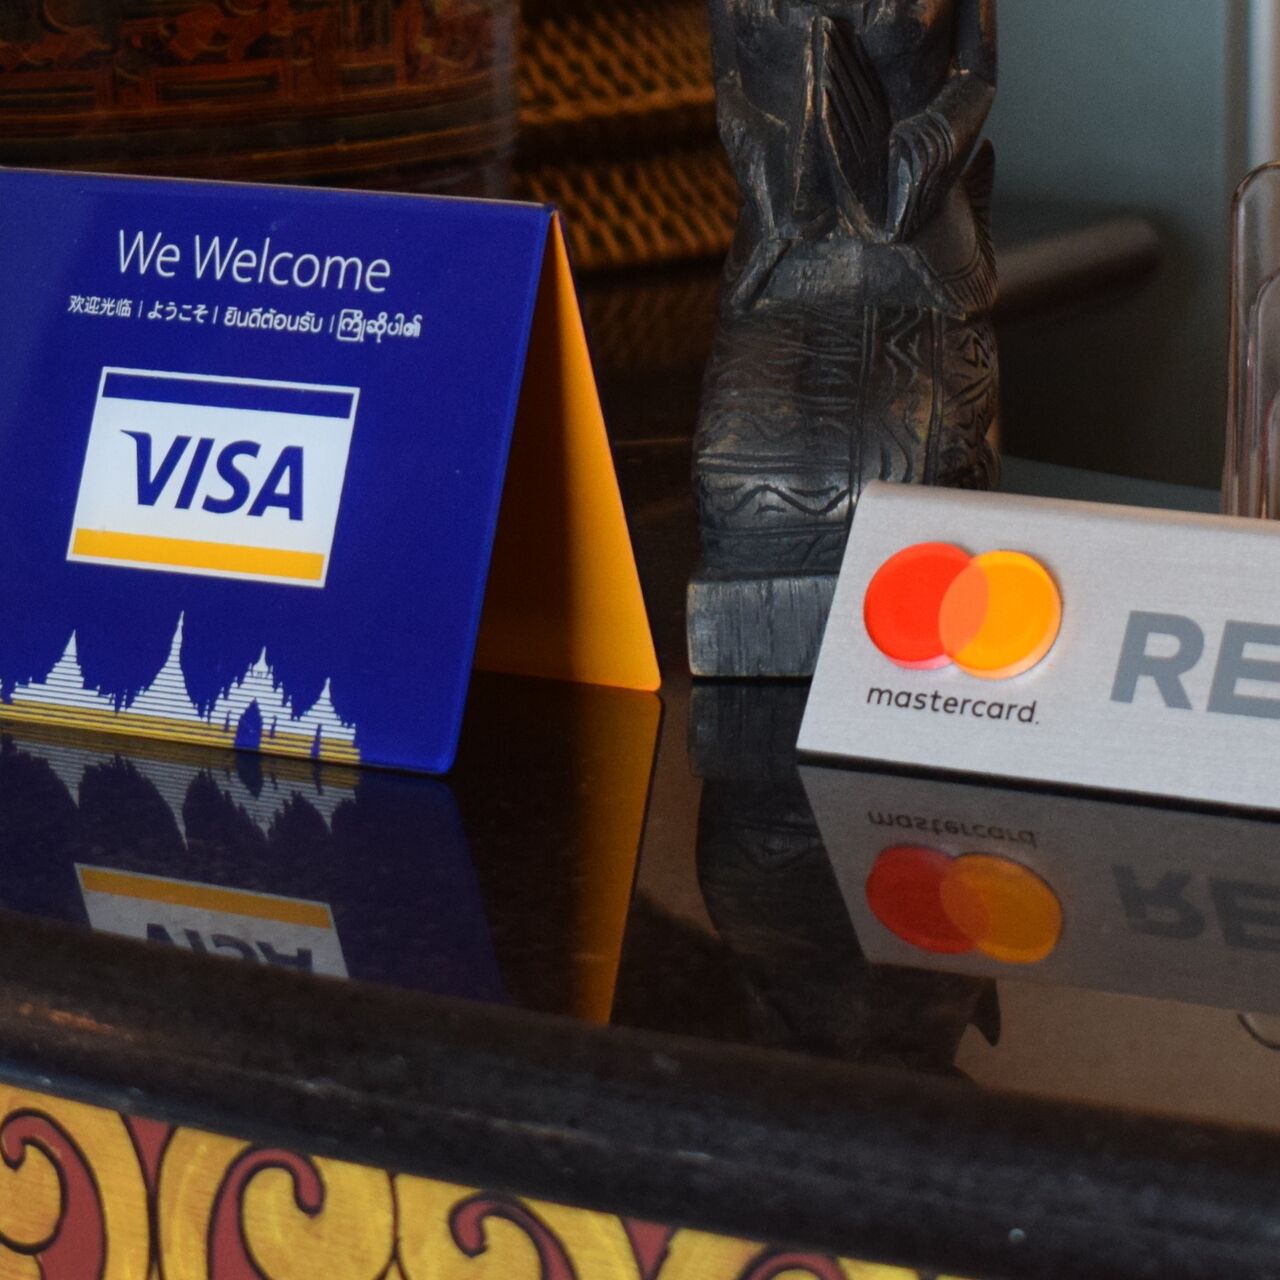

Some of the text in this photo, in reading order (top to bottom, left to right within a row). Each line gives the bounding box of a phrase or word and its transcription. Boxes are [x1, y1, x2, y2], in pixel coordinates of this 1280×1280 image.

[119, 229, 391, 293] We Welcome
[68, 295, 133, 318] 欢迎光临
[147, 300, 209, 324] ようこそ
[223, 306, 324, 333] ยินดีต้อนรับ
[120, 428, 304, 521] VISA
